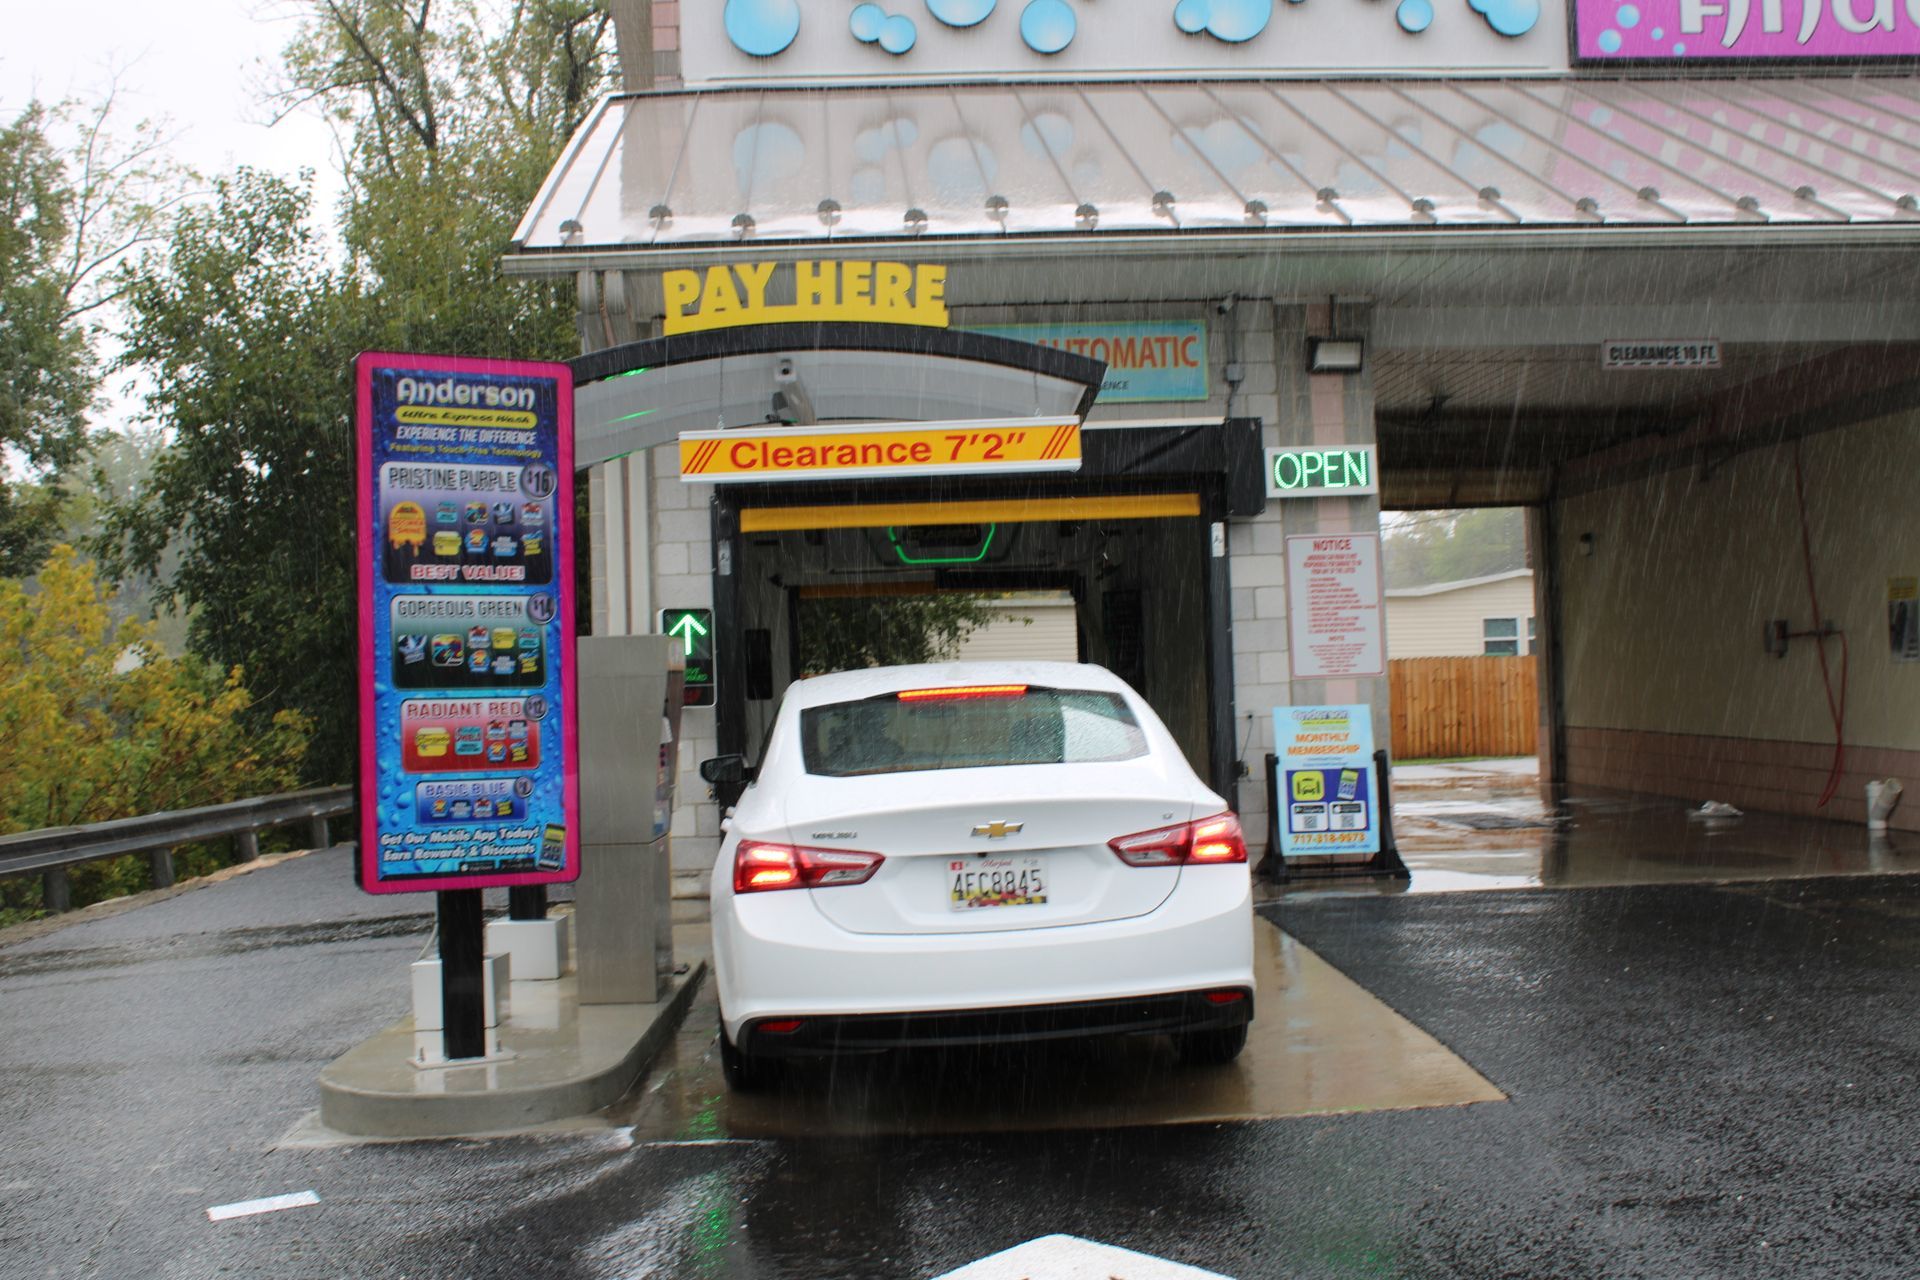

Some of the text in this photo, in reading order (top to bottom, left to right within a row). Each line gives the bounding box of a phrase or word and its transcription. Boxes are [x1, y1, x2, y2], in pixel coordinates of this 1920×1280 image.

[662, 260, 948, 318] PAY HERE
[1609, 345, 1680, 361] CLEARANCE
[397, 377, 535, 410] Anderson
[441, 411, 493, 423] Express
[496, 415, 530, 424] Wash
[396, 426, 537, 445] EXPERIENCE THE DIFFERENCE
[729, 438, 932, 470] Clearance
[1273, 449, 1369, 489] OPEN
[389, 467, 550, 493] PRISTINE PURPLE $16
[1312, 538, 1352, 551] NOTICE
[411, 564, 525, 580] BEST VALUE!
[398, 600, 474, 618] GORGEOUS
[478, 600, 523, 617] GREEN
[407, 702, 483, 718] RADIANT
[488, 701, 522, 717] RED
[1295, 732, 1350, 743] MONTHLY
[1287, 744, 1360, 756] MEMBERSHIP
[425, 784, 468, 798] BASIC
[471, 782, 507, 796] BLUE
[380, 826, 540, 846] Get Our Mobile App Today!
[384, 843, 536, 862] Earn Rewards & Discounts
[953, 868, 1043, 897] 4FC8845
